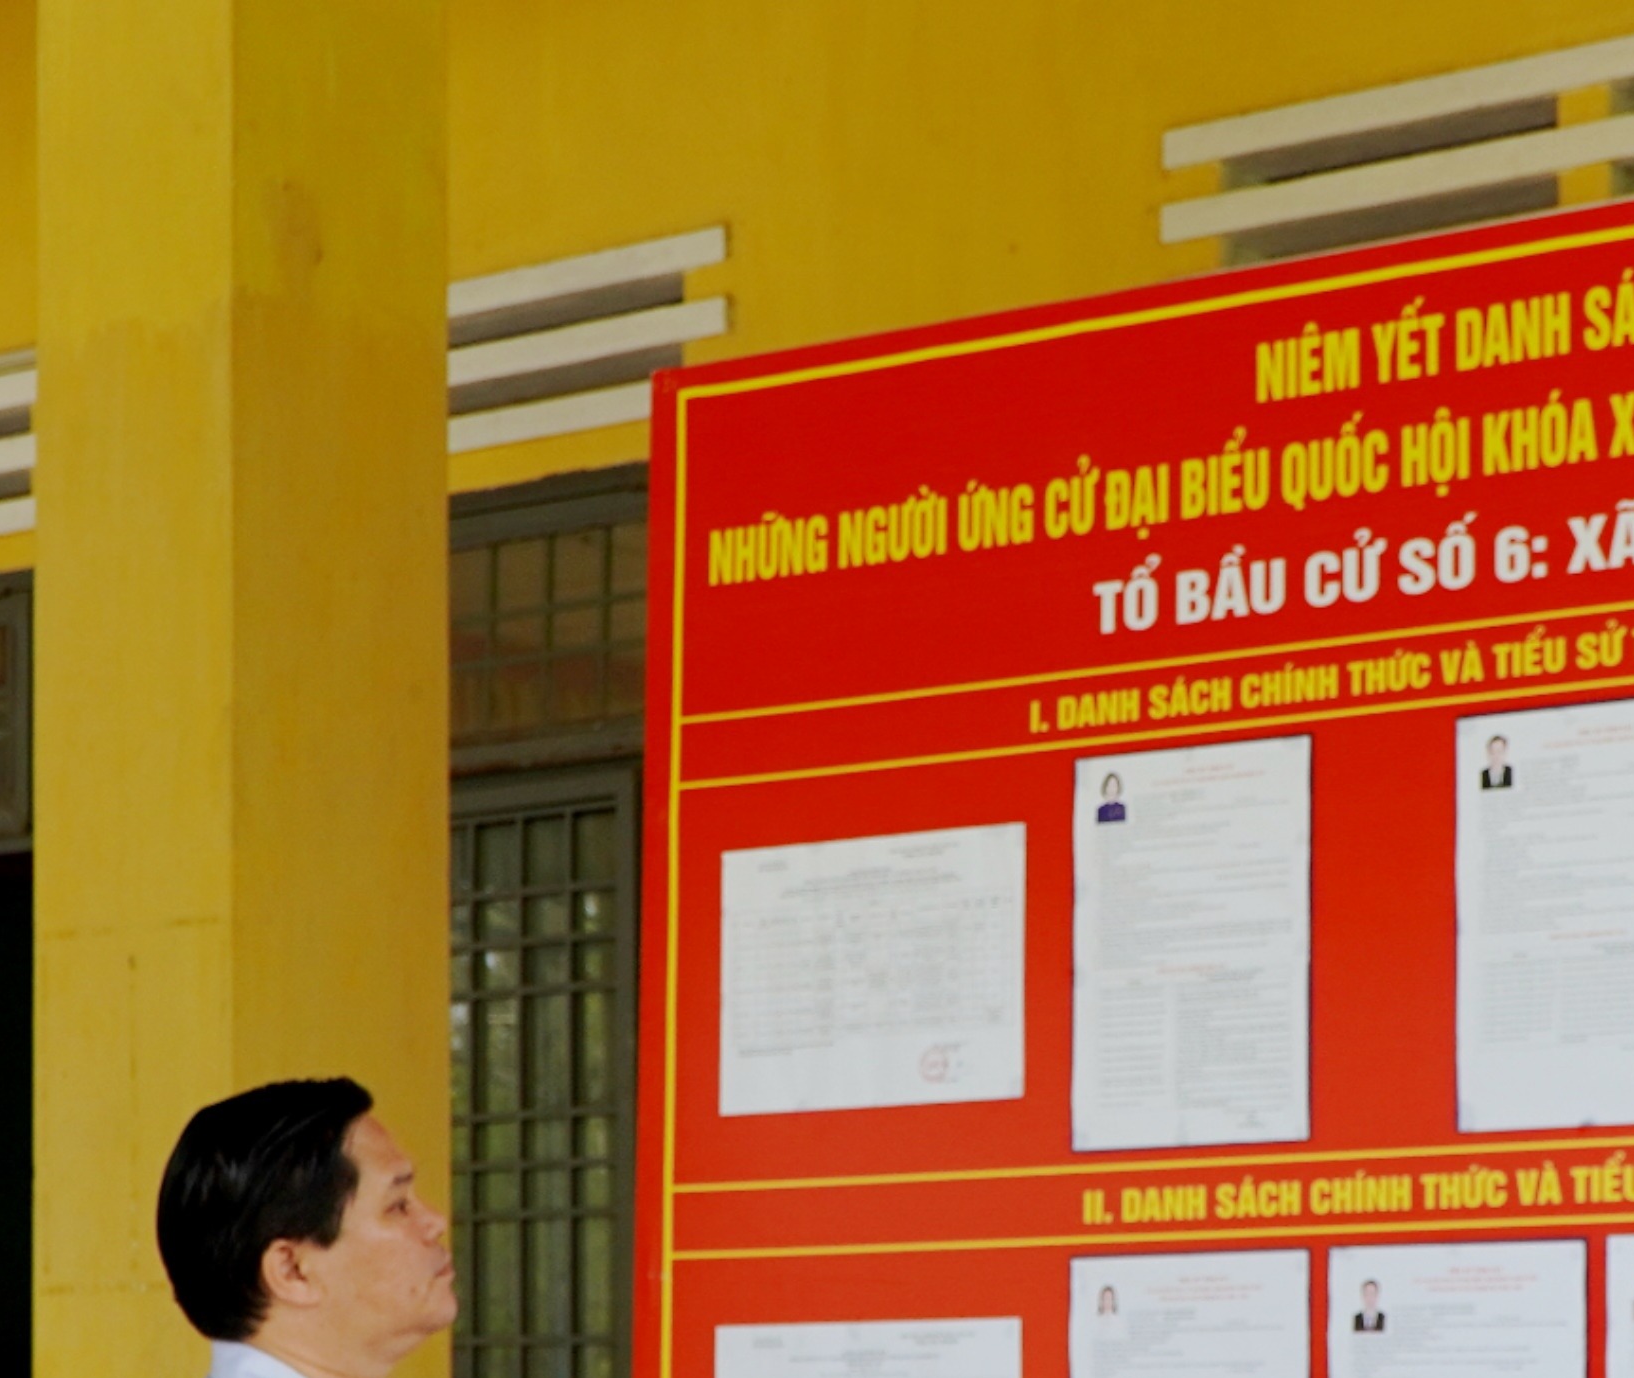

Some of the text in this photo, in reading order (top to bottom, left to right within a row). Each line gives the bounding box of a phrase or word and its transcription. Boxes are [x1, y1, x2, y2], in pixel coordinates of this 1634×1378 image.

[1255, 321, 1360, 404] NIÊM
[1371, 296, 1445, 384] YẾT
[1455, 291, 1571, 372] DANH
[708, 511, 828, 587] NHỮNG
[837, 484, 948, 569] NGƯỜI
[958, 479, 1034, 552] ỨNG
[1044, 454, 1100, 539] CỬ
[1104, 463, 1170, 540] ĐẠI
[1180, 426, 1270, 520] BIỂU
[1281, 411, 1389, 511] QUỐC
[1401, 406, 1470, 497] HỘI
[1482, 388, 1598, 476] KHÓA
[1092, 553, 1162, 635] TỔ
[1175, 544, 1286, 625] BẦU
[1304, 527, 1388, 608] CỬ
[1397, 511, 1477, 595] SỐ
[1494, 525, 1548, 583] 6:
[1029, 700, 1049, 733] I.
[1057, 688, 1140, 730] DANH
[1148, 677, 1232, 720] SÁCH
[1240, 663, 1339, 709] CHÍNH
[1347, 650, 1431, 696] THỨC
[1440, 641, 1484, 685] VÀ
[1492, 626, 1566, 679] TIỂU
[1576, 619, 1627, 670] SỬ
[1083, 1190, 1113, 1224] II.
[1121, 1185, 1207, 1223] DANH
[1215, 1178, 1301, 1219] SÁCH
[1310, 1172, 1412, 1215] CHÍNH
[1420, 1166, 1507, 1210] THỨC
[1516, 1162, 1562, 1206] VÀ
